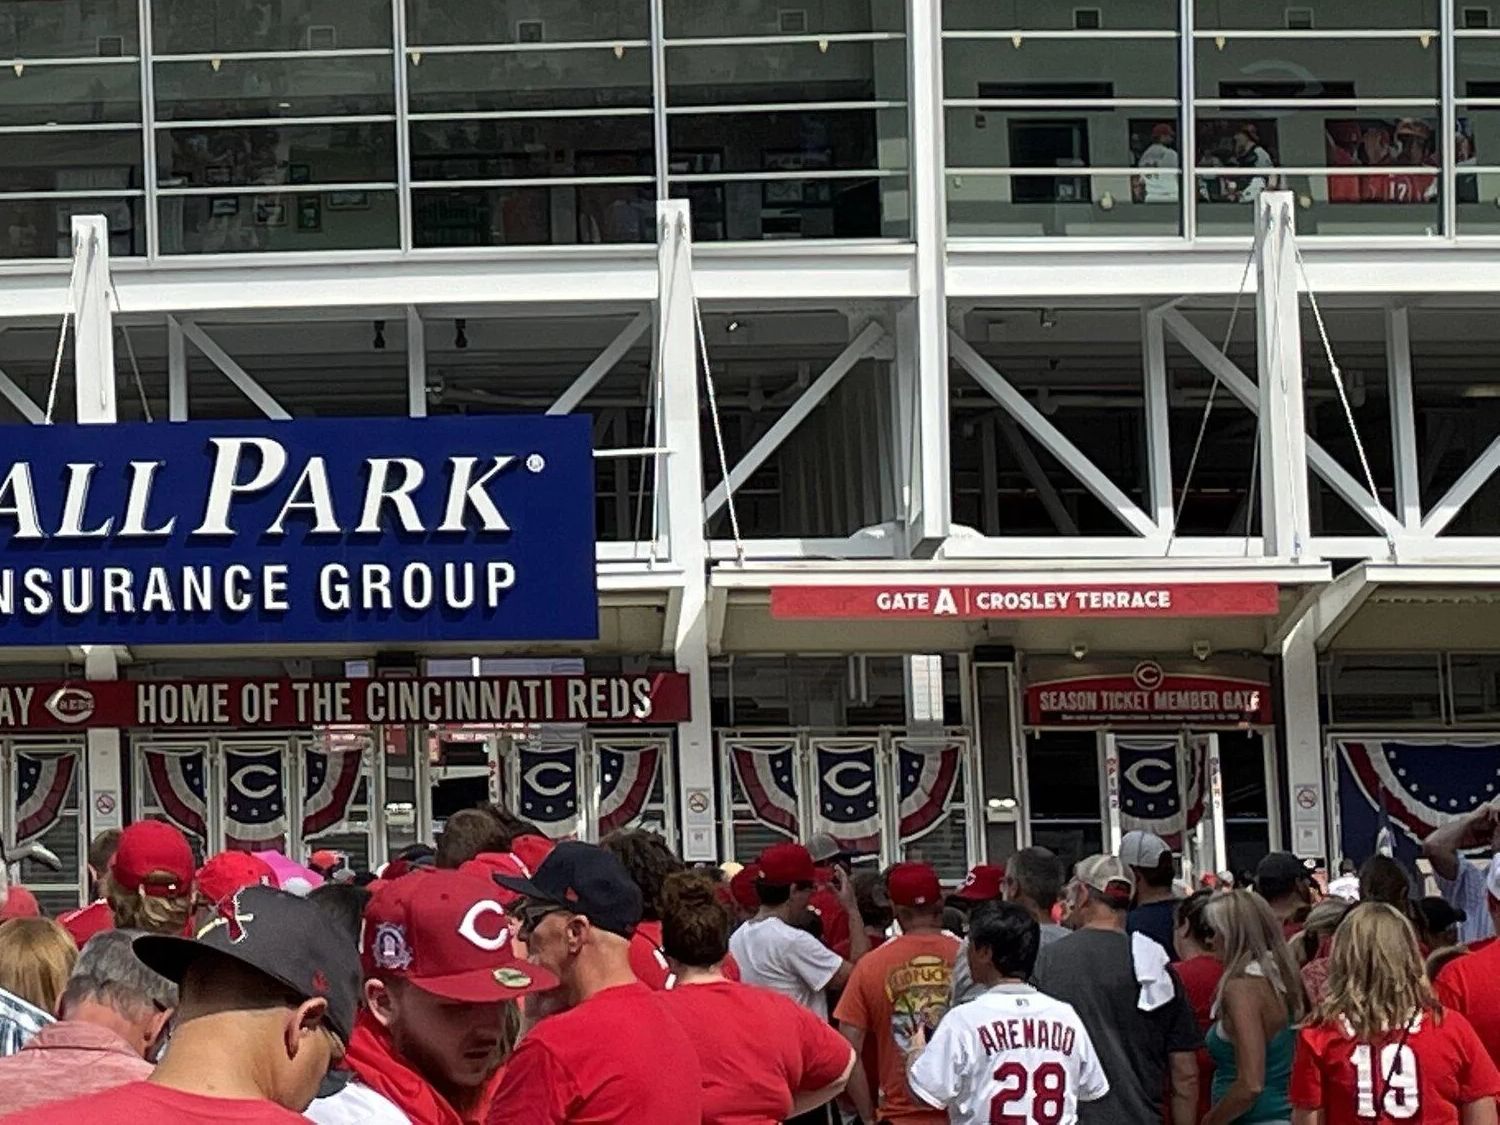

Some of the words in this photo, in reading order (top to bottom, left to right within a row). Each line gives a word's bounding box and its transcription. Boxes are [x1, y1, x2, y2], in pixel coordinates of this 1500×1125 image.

[319, 560, 517, 611] GROUP
[875, 592, 929, 611] GATE
[932, 587, 959, 616] A
[976, 591, 1072, 611] CROSLEY
[1076, 590, 1172, 610] TERRACE
[137, 683, 229, 724] HOME
[240, 682, 280, 723] OF
[292, 681, 352, 722] THE
[366, 678, 554, 722] CINCINNATI
[567, 677, 653, 719] REDS
[1039, 691, 1098, 712] SEASON
[1100, 691, 1150, 711] TICKET
[1153, 690, 1220, 712] MEMBER
[1222, 690, 1260, 712] GATE
[977, 1018, 1076, 1057] ARENADO
[989, 1061, 1067, 1125] 28
